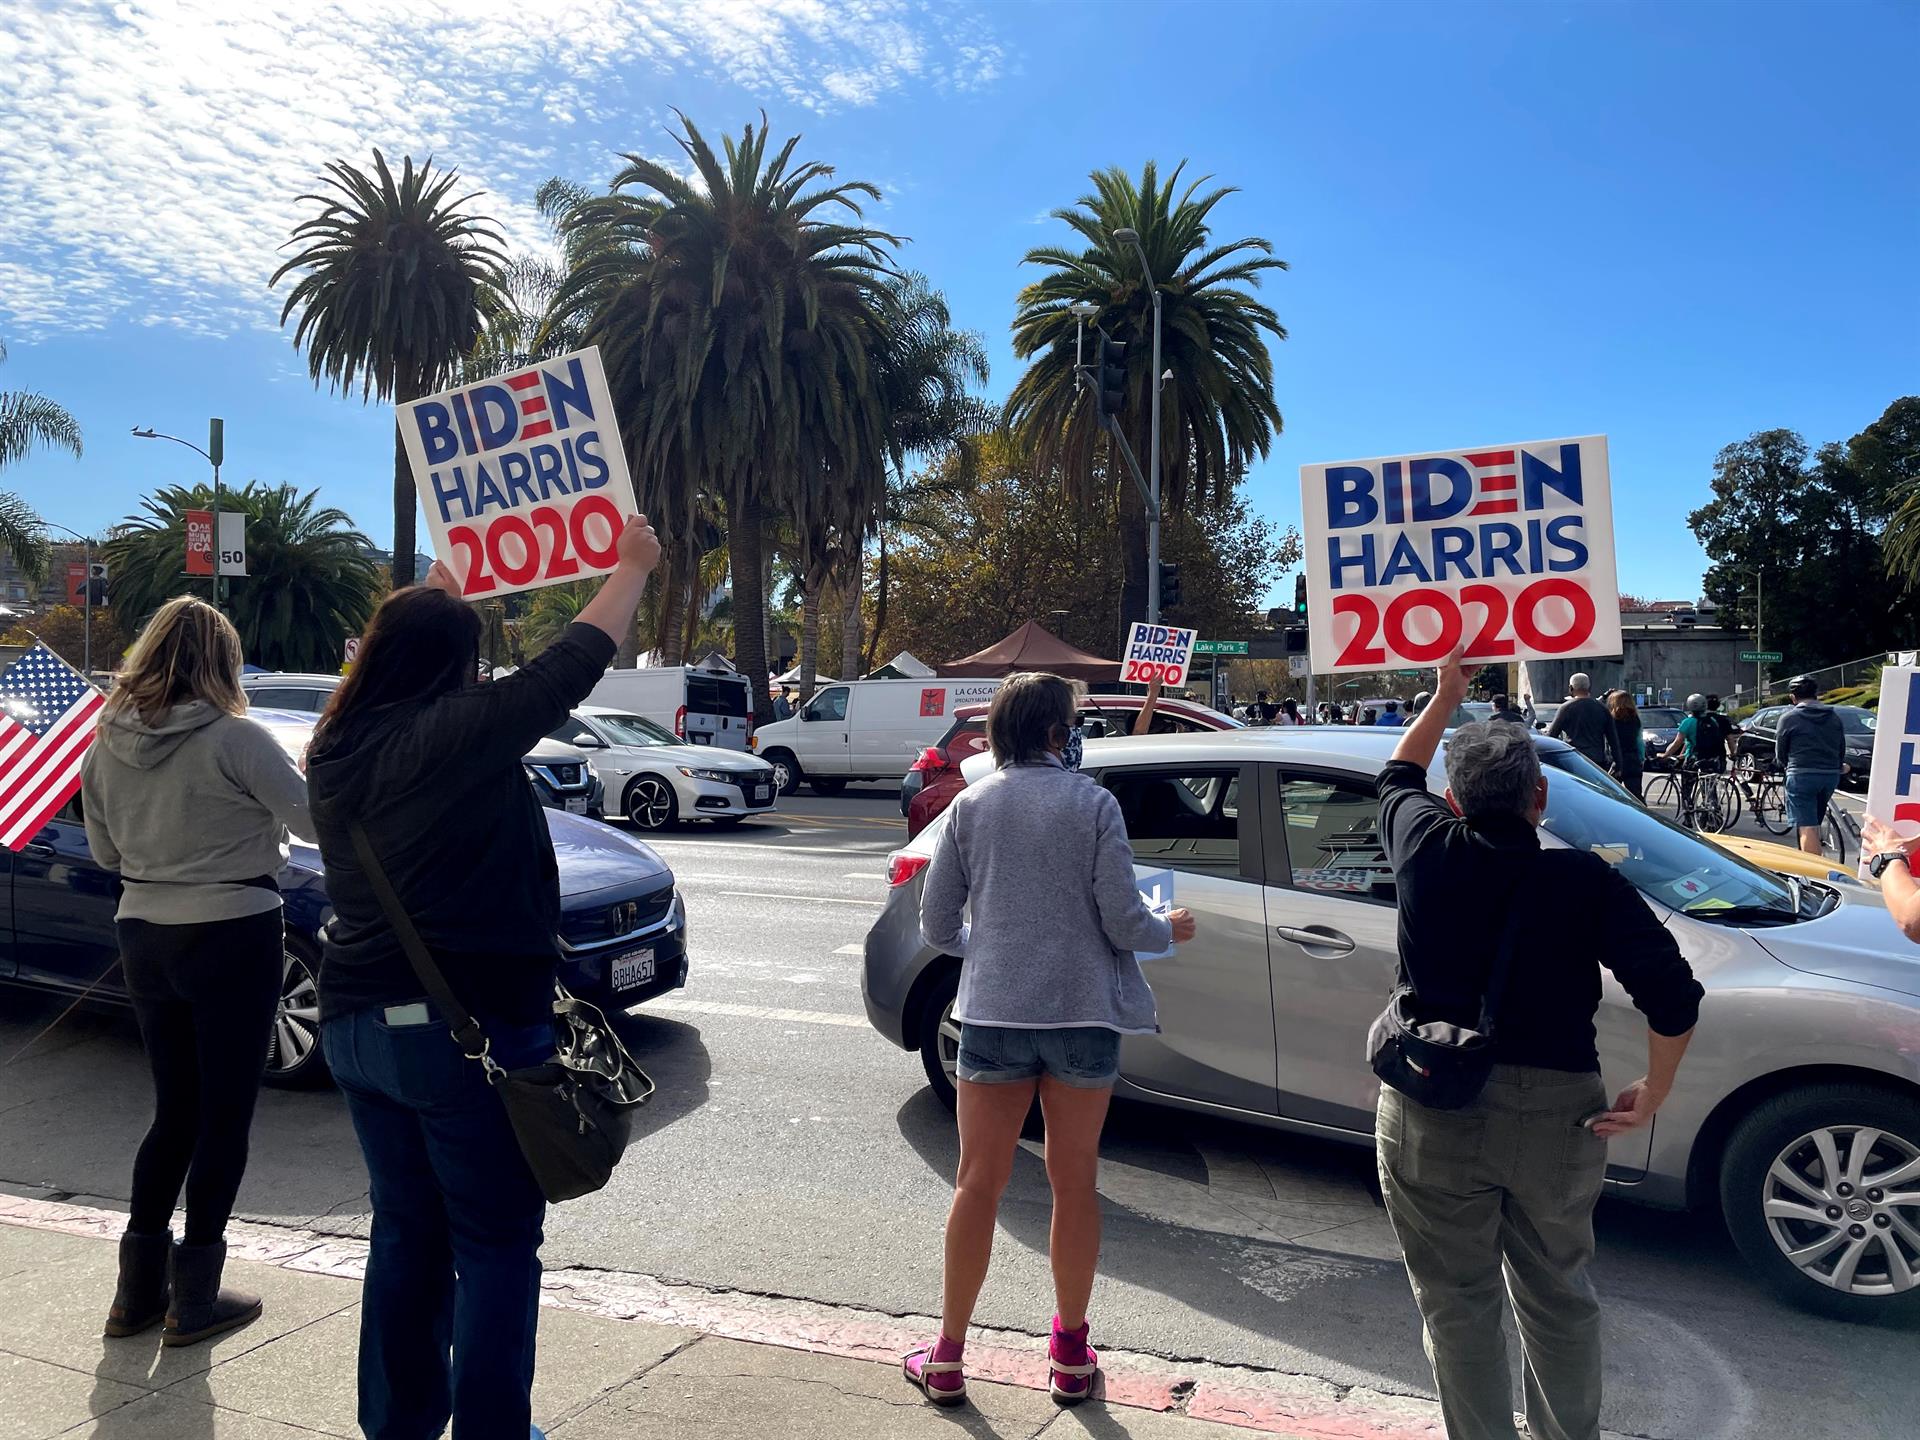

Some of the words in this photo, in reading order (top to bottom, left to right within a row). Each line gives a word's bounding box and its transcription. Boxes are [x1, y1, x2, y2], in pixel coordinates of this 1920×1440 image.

[413, 358, 595, 466] BIDEN
[431, 431, 610, 523] HARRIS
[1325, 443, 1584, 529] BIDEN
[447, 495, 625, 596] 2020
[1328, 515, 1589, 589] HARRIS
[1130, 644, 1187, 665] HARRIS
[1134, 625, 1192, 648] BIDEN
[1196, 642, 1214, 651] Lake
[1217, 642, 1234, 651] Park
[1332, 578, 1596, 666] 2020
[614, 960, 653, 986] 8BHA657
